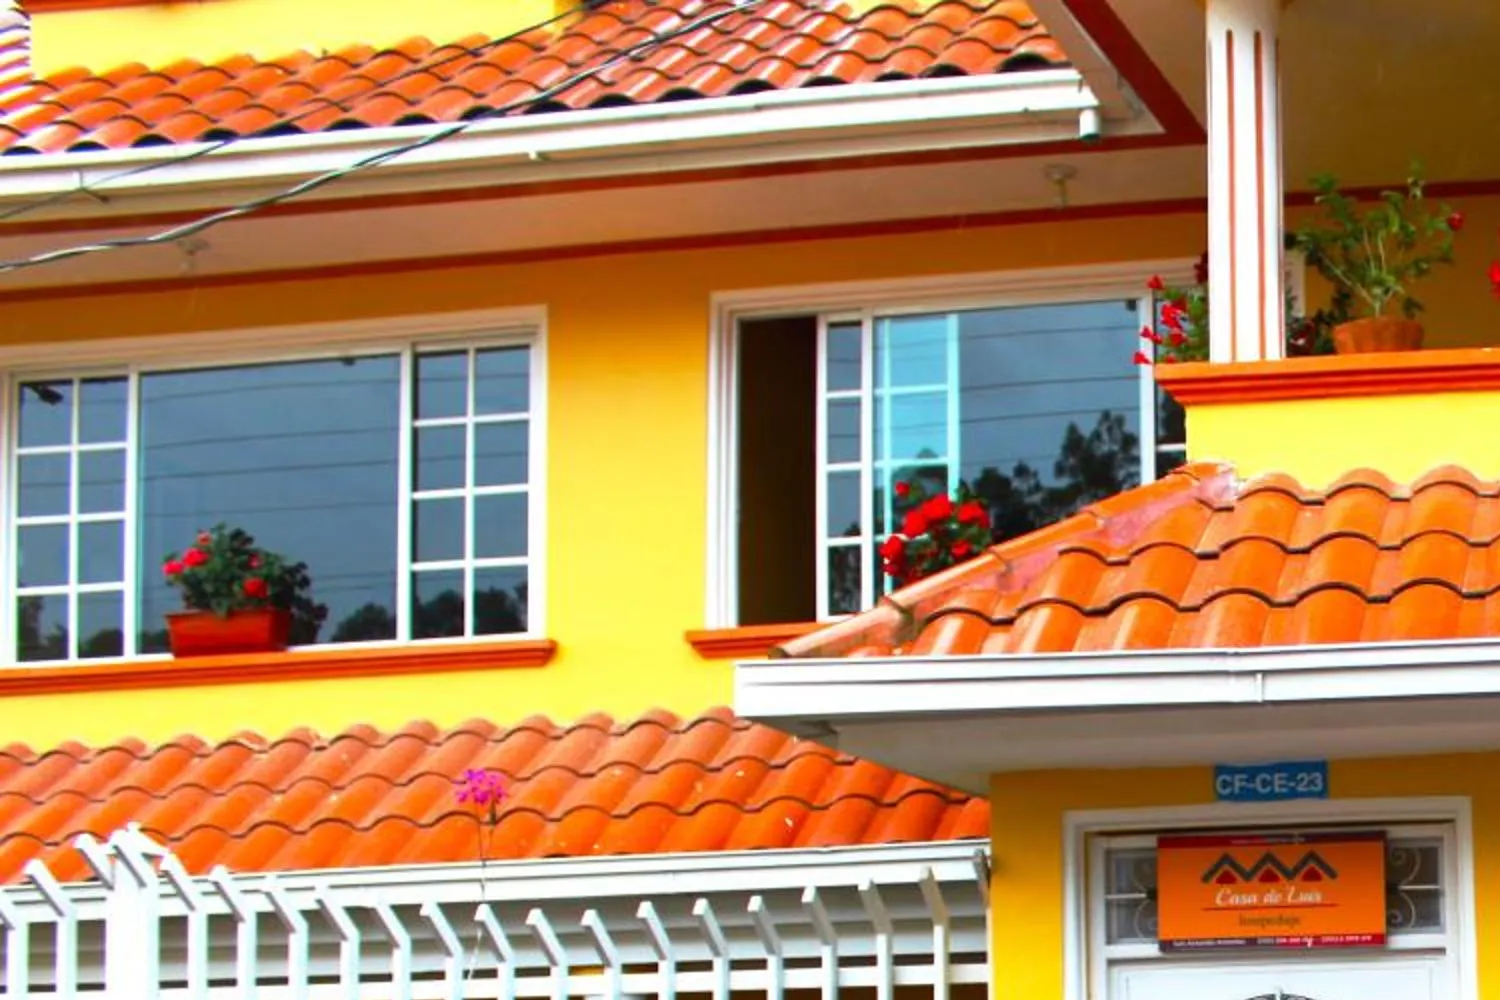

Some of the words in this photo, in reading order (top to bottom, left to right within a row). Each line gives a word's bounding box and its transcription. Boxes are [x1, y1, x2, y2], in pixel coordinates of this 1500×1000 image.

[1216, 772, 1323, 795] CF-CE-23
[1215, 888, 1257, 906] Casa
[1263, 888, 1282, 904] de
[1287, 885, 1322, 904] Luis
